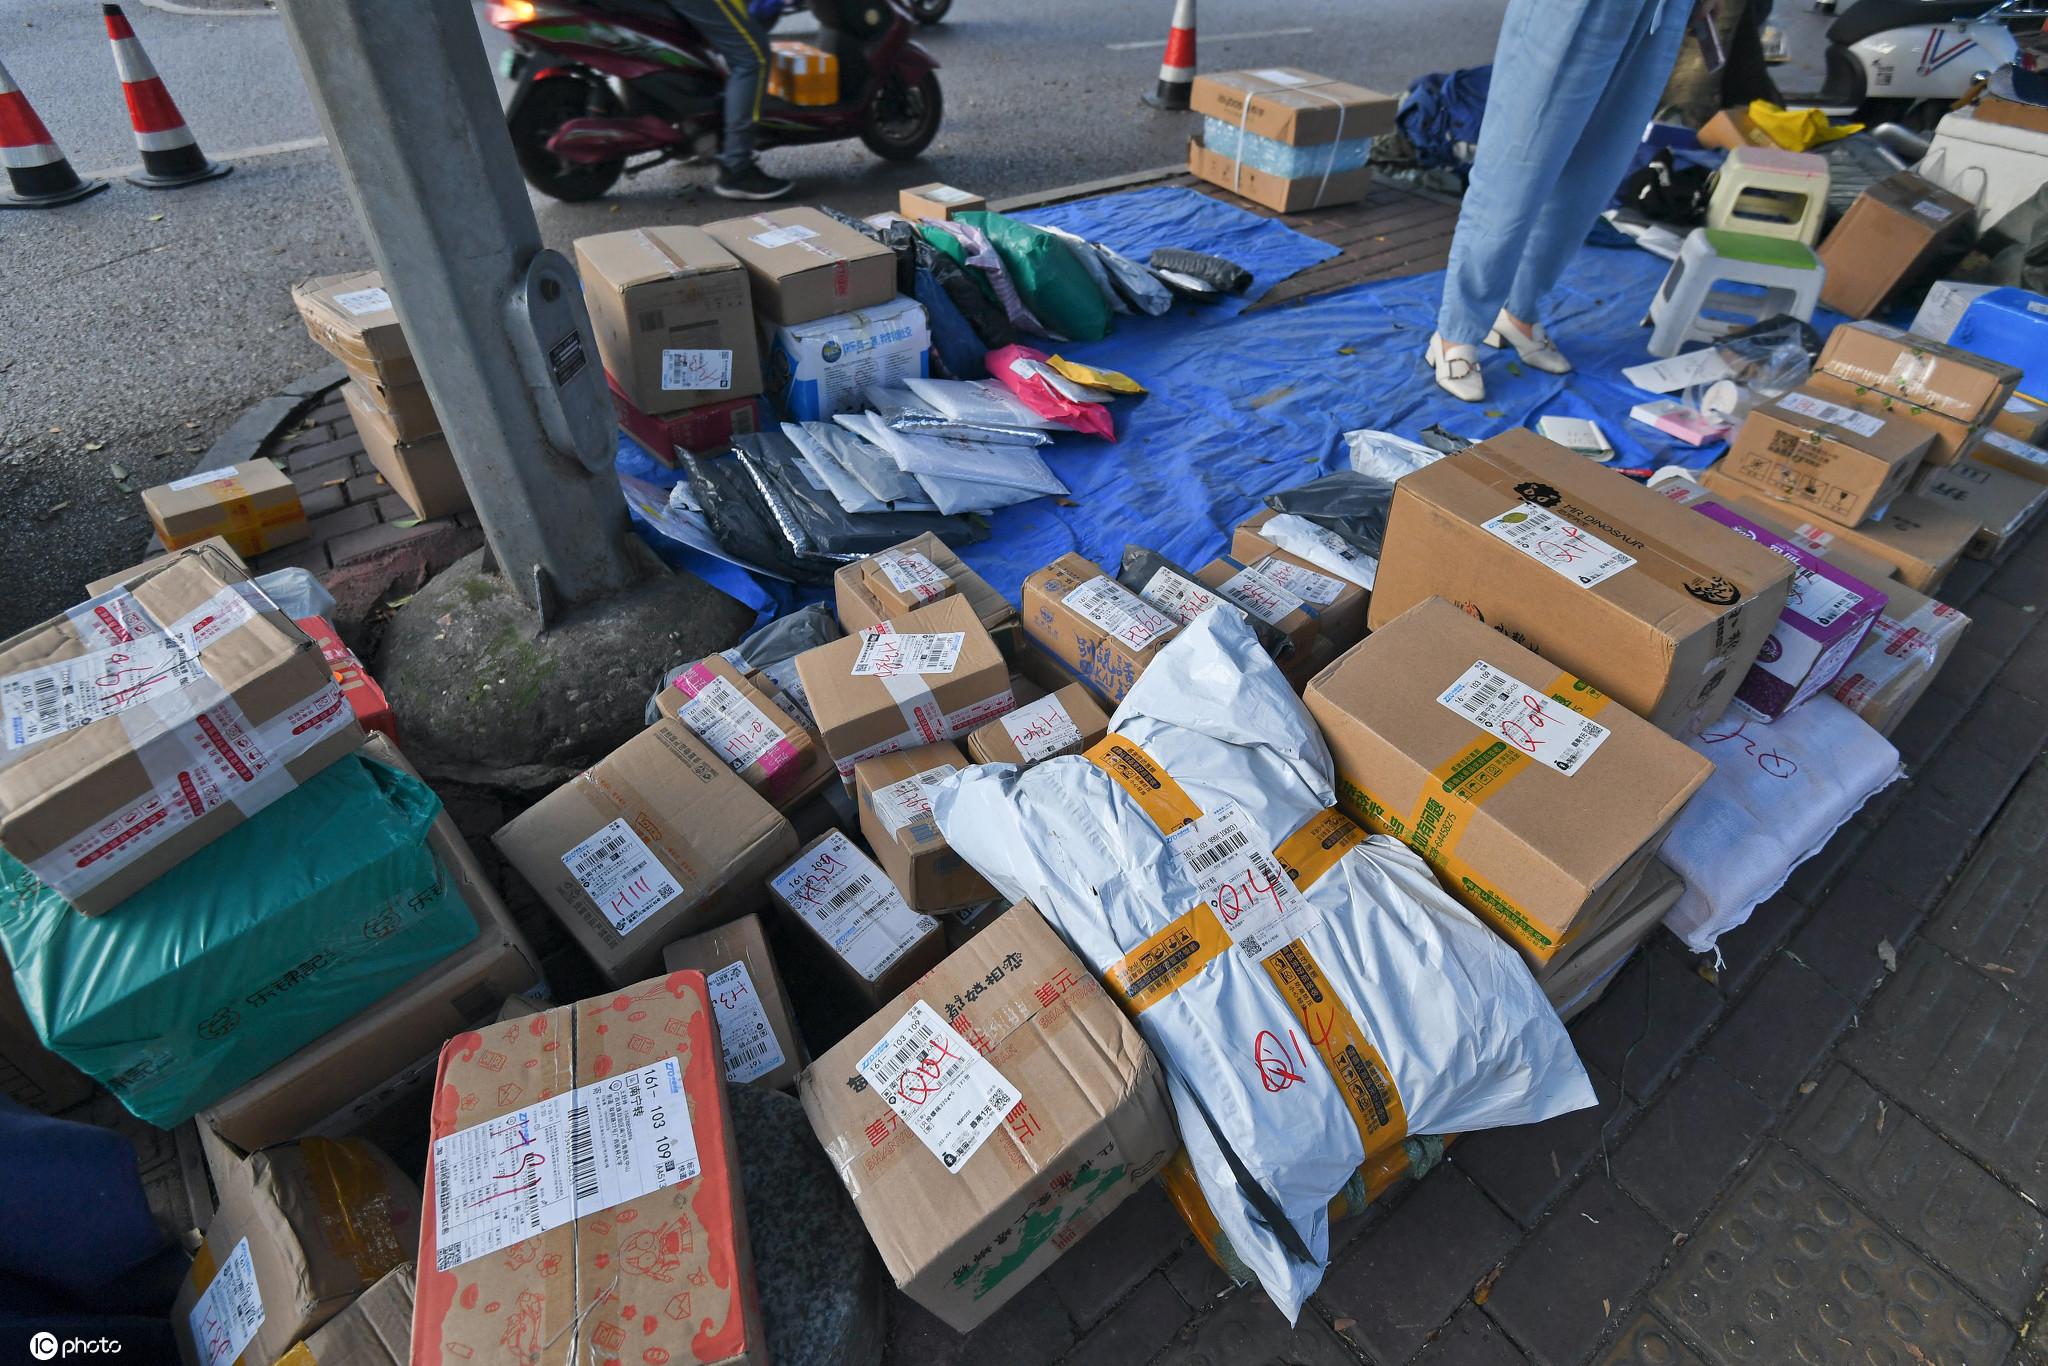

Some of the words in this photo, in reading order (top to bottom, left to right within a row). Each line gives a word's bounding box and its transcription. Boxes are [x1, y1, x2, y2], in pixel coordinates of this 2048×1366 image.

[1584, 513, 1645, 551] DINOSAUR
[787, 870, 808, 889] 161-
[1032, 967, 1077, 1007] 善元
[891, 1033, 907, 1049] 103
[906, 1019, 922, 1035] 109
[642, 1068, 660, 1099] 161-
[664, 1061, 675, 1077] ZTO
[627, 1085, 643, 1118] 南宁转
[649, 1105, 666, 1129] 103
[654, 1134, 672, 1160] 109
